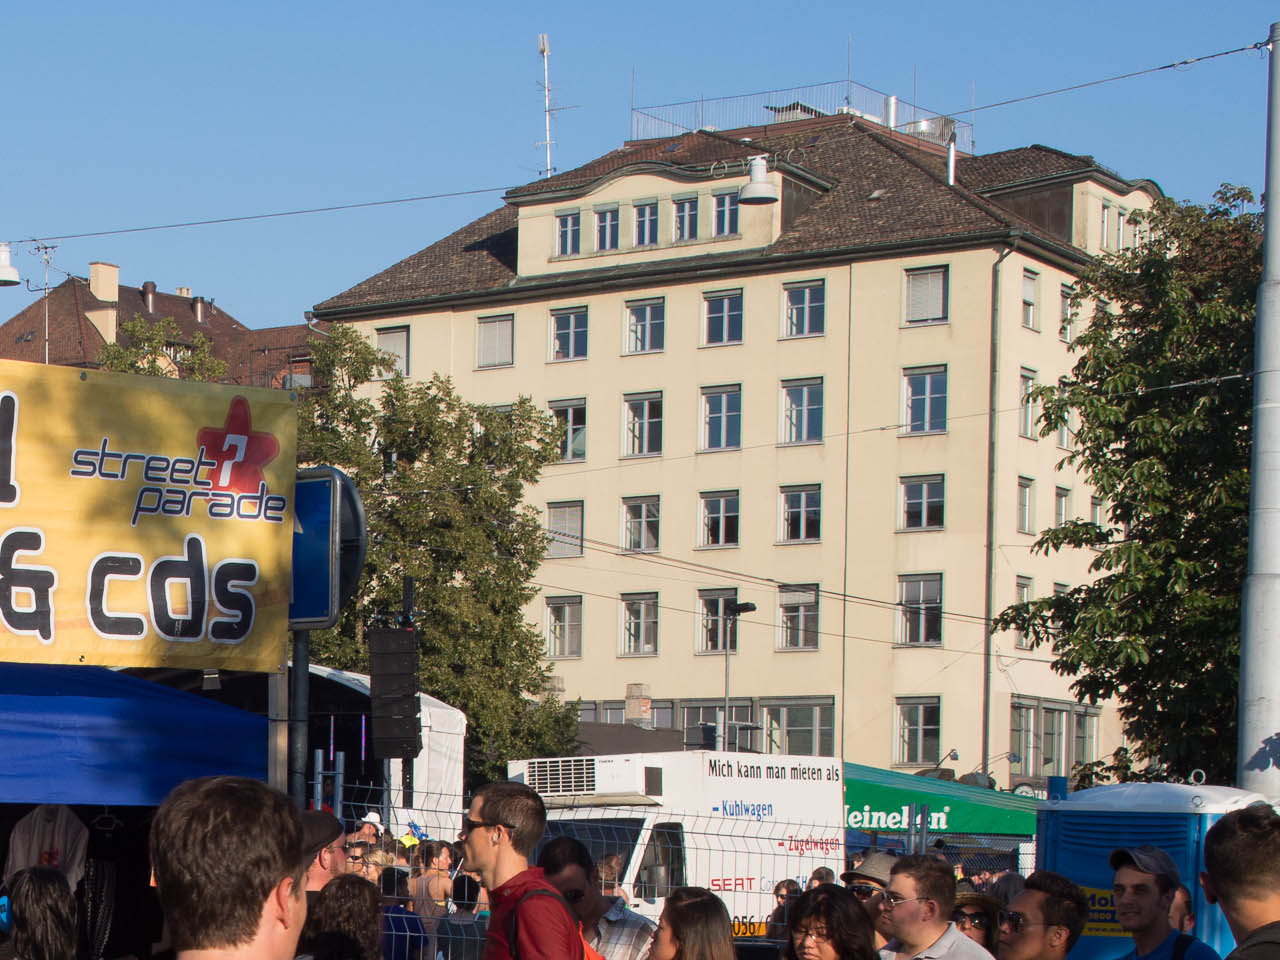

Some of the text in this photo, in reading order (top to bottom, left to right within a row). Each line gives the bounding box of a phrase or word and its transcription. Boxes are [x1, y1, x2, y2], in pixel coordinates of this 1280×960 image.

[69, 437, 217, 488] street
[130, 480, 288, 527] parade
[86, 532, 260, 644] cds
[708, 759, 840, 781] Mich kann man mieten als
[710, 877, 756, 892] SEAT
